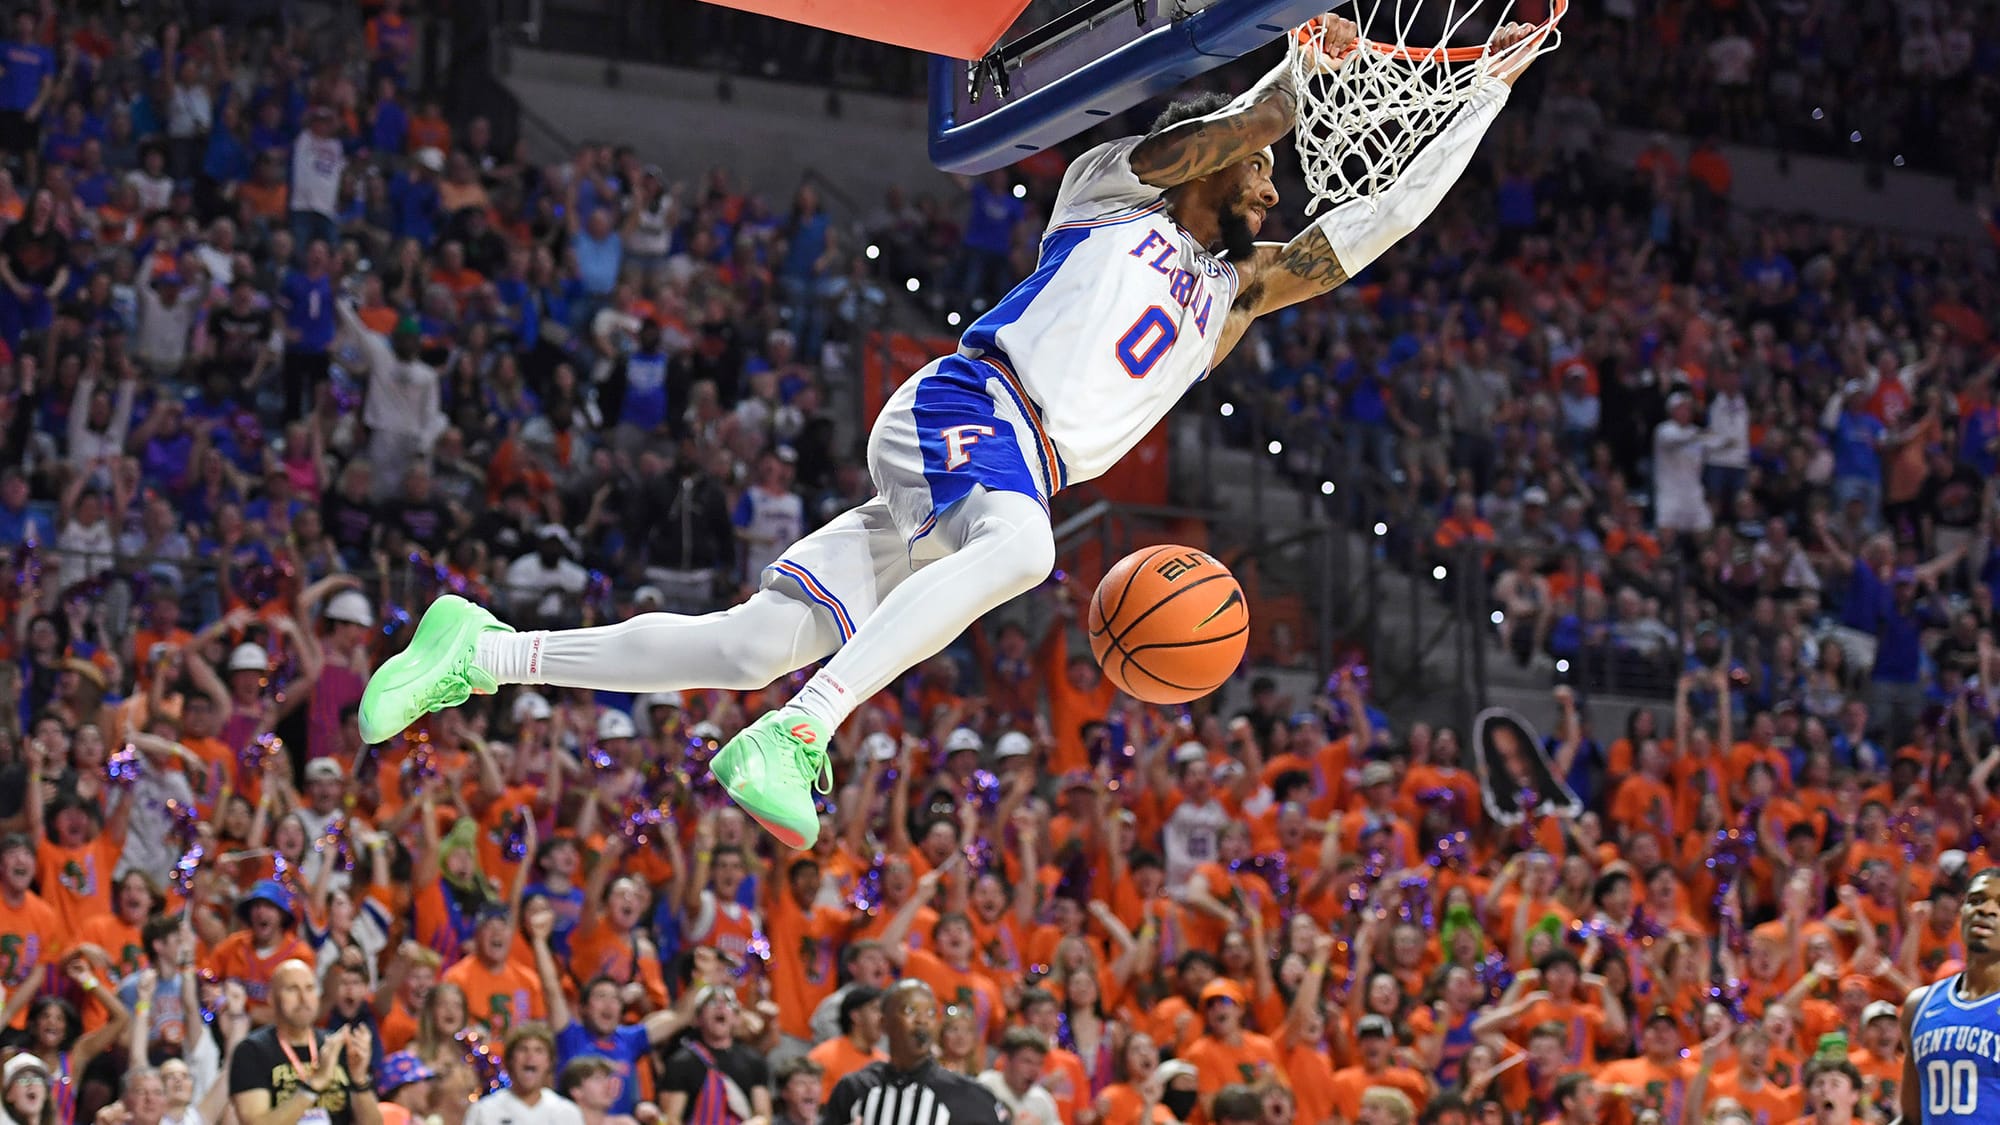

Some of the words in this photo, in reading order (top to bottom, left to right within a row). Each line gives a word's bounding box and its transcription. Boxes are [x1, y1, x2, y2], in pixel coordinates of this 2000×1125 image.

[1128, 228, 1213, 339] FLRA
[1115, 305, 1178, 379] 0
[941, 424, 995, 472] F
[1927, 1060, 1978, 1115] 00
